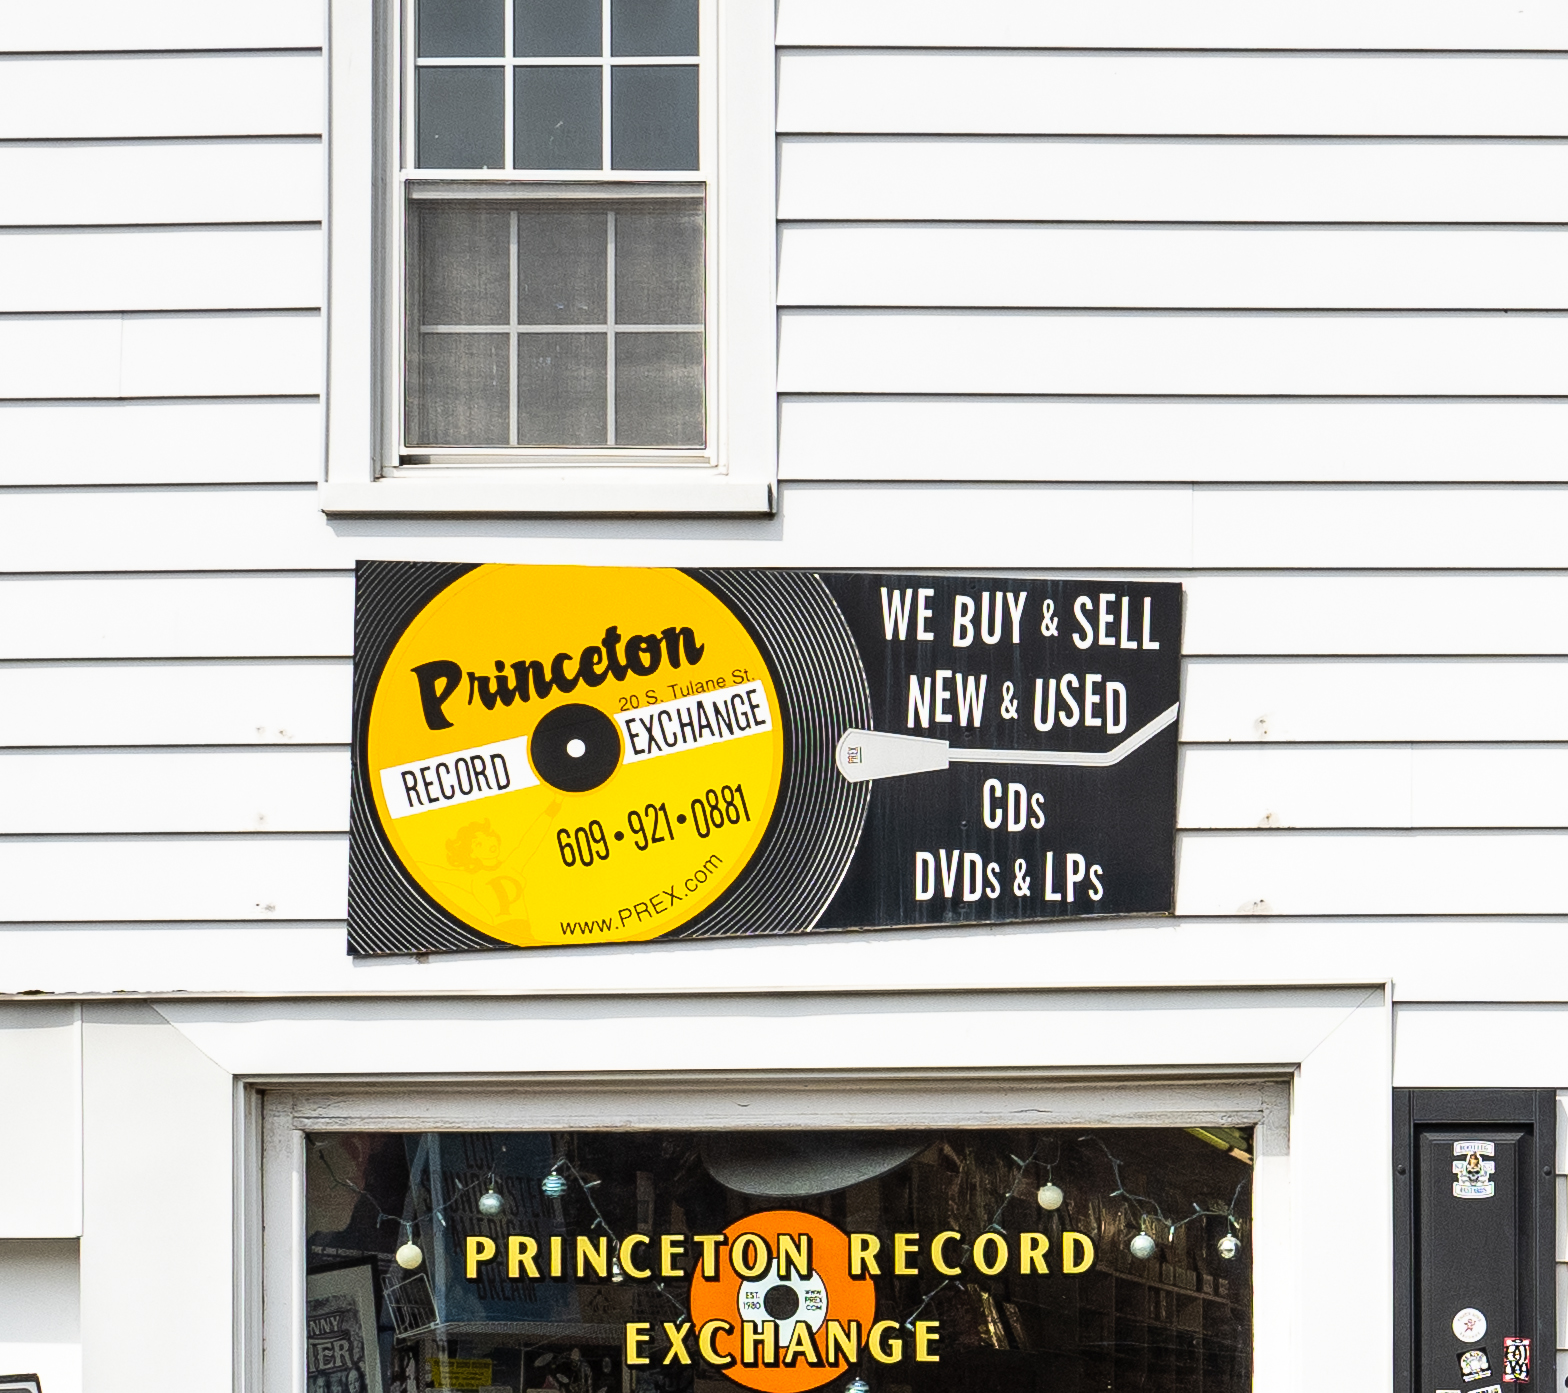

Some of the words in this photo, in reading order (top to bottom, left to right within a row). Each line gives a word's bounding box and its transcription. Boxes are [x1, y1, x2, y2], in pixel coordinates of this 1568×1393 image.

[880, 587, 935, 641] WE
[952, 591, 1027, 648] BUY
[1040, 599, 1059, 637] &
[1072, 593, 1160, 650] SELL
[411, 625, 704, 731] Princeton
[619, 696, 640, 712] 20
[645, 689, 663, 705] S.
[672, 675, 727, 697] Tulane
[732, 668, 755, 686] St.
[907, 669, 988, 728] NEW
[1000, 680, 1019, 720] &
[1033, 673, 1128, 734] USED
[625, 687, 767, 755] EXCHANGE
[401, 752, 511, 808] RECORD
[982, 778, 1046, 832] CDs
[560, 853, 724, 936] www.PREX.com
[915, 848, 1001, 902] DVDs
[1013, 858, 1031, 897] &
[1044, 851, 1104, 903] LPs
[466, 1233, 813, 1281] PRINCETON
[850, 1232, 1099, 1277] RECORD
[743, 1301, 761, 1310] 1980
[745, 1291, 760, 1299] EST.
[625, 1321, 943, 1368] EXCHANGE
